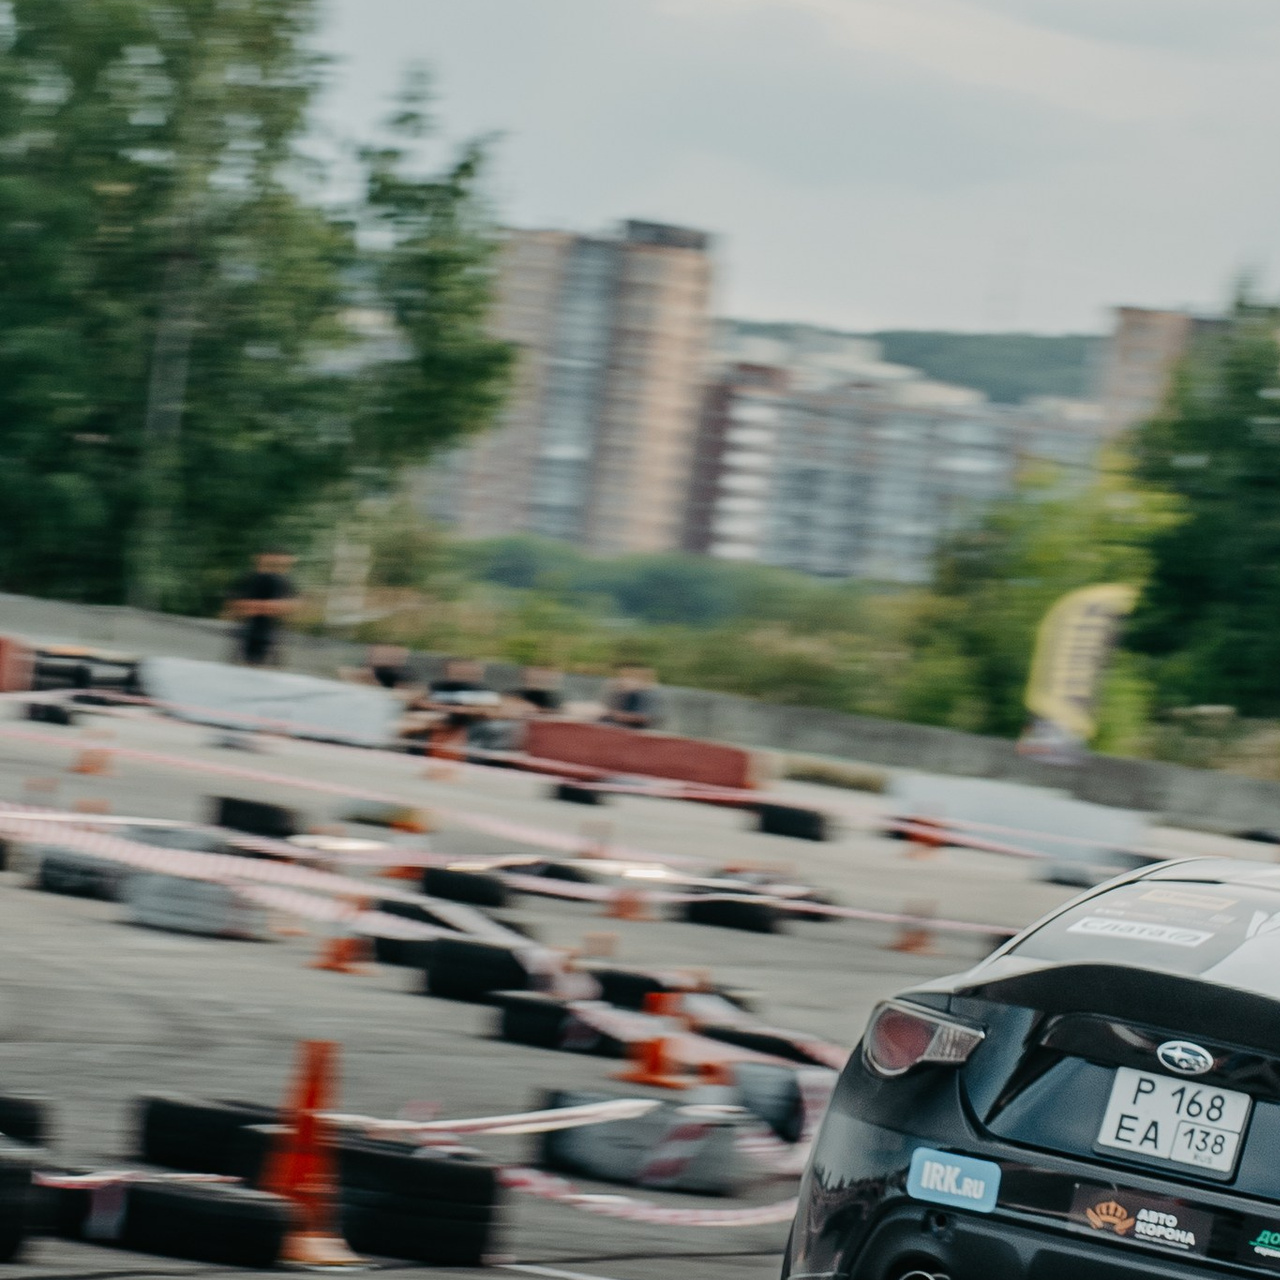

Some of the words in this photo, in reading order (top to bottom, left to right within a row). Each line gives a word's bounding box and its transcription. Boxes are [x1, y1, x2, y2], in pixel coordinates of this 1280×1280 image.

[1171, 1086, 1226, 1122] 168
[1183, 1128, 1226, 1156] 138
[920, 1160, 986, 1200] IRK.RU
[1136, 1208, 1178, 1228] АВТО
[1134, 1220, 1196, 1246] КОРОНА
